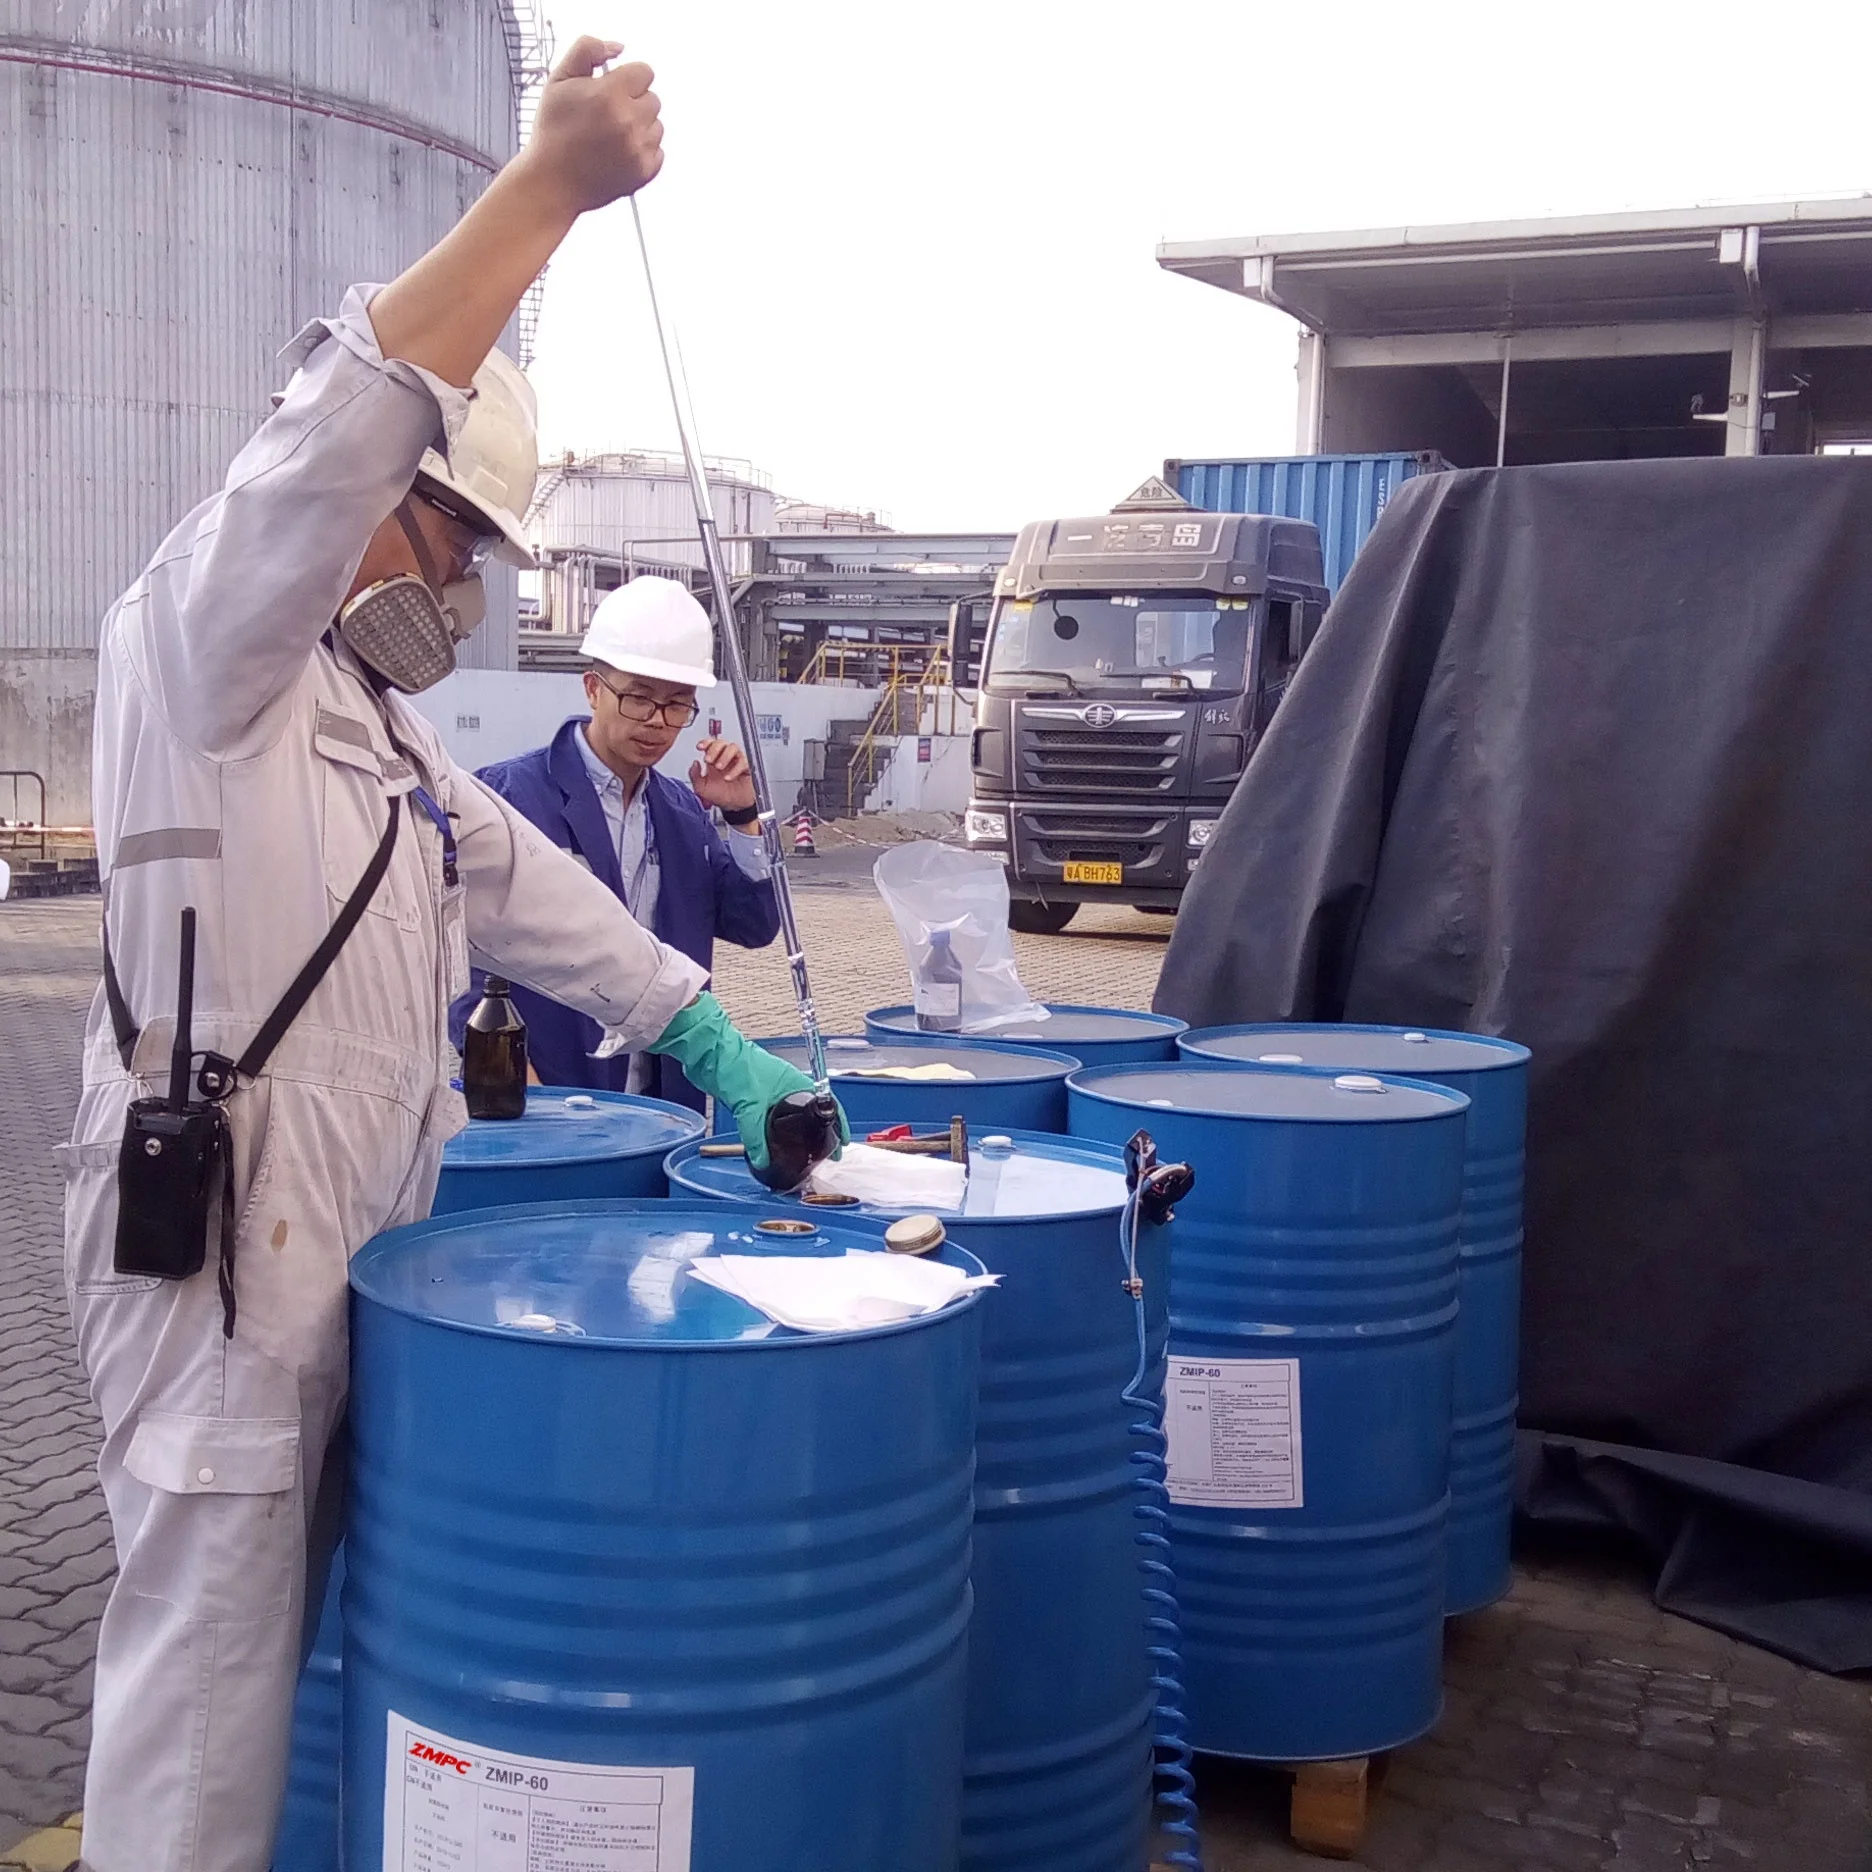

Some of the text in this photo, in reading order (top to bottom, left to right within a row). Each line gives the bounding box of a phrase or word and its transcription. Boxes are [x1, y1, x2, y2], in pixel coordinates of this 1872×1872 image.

[1179, 1366, 1221, 1378] ZMIP-60
[408, 1742, 472, 1775] ZMPC
[485, 1766, 549, 1791] ZMIP-60
